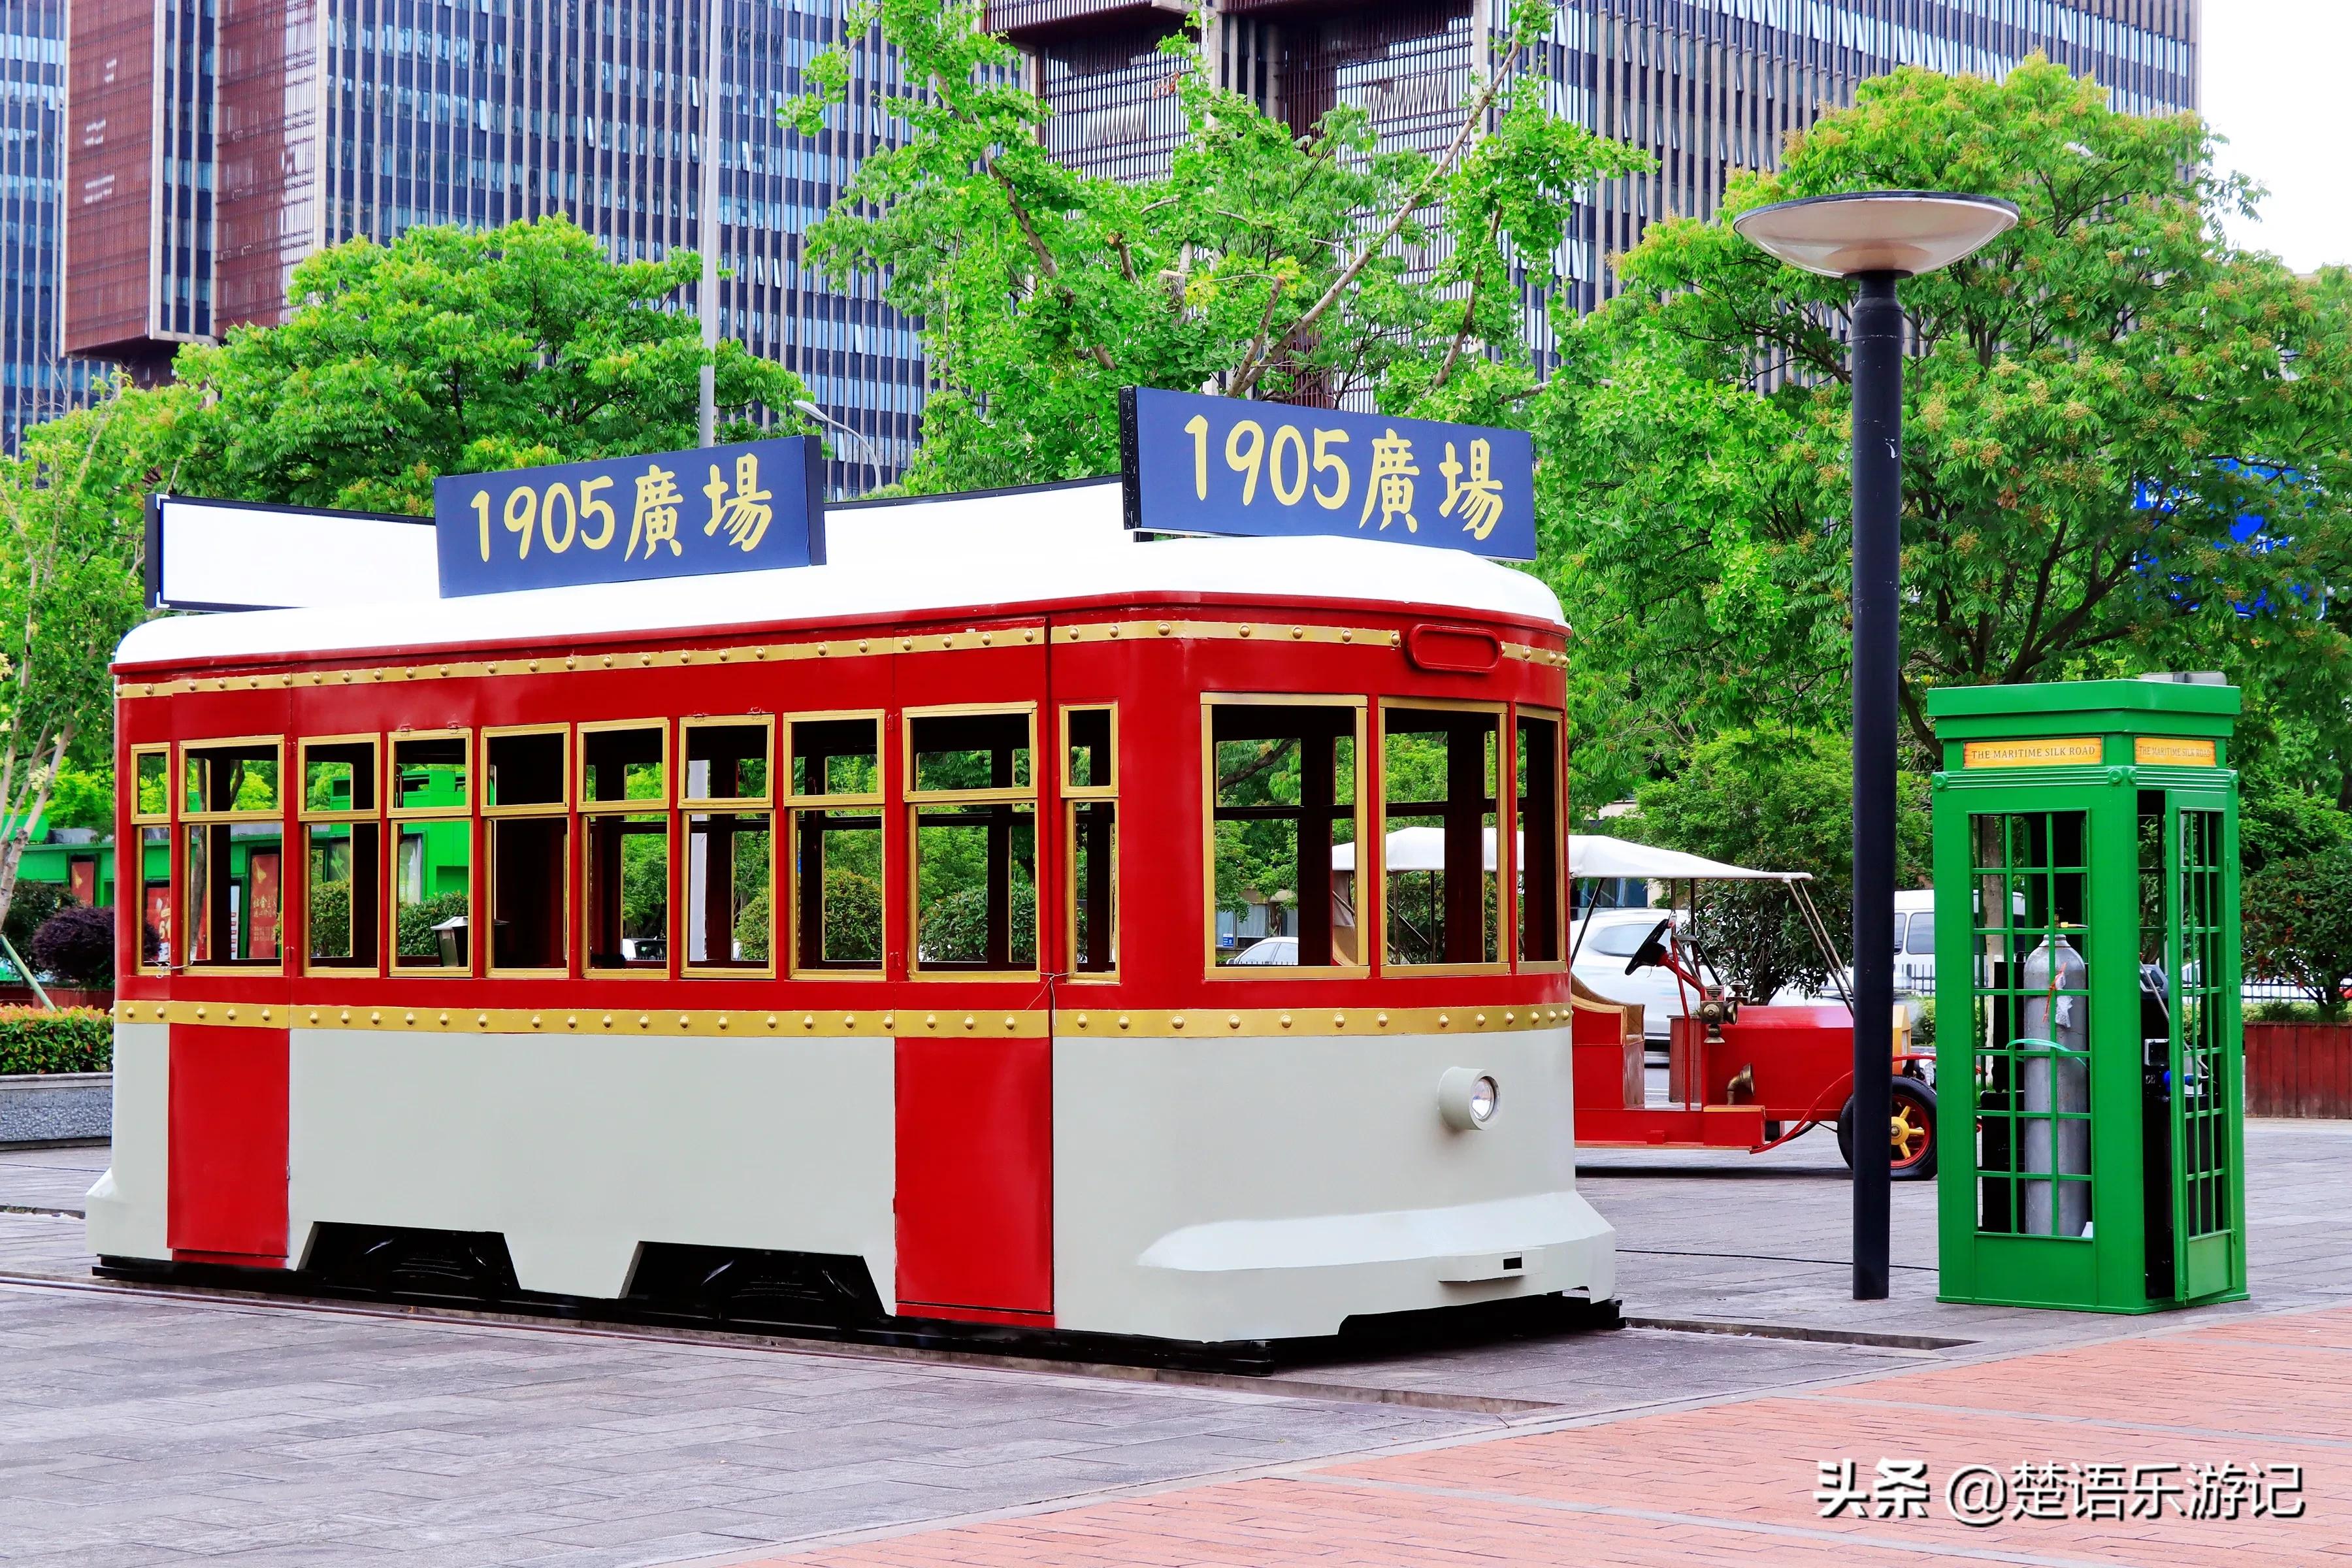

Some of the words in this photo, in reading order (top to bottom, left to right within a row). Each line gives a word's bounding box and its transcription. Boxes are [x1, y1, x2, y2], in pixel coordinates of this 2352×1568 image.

[470, 452, 773, 562] 1905廣場
[1184, 414, 1503, 541] 1905廣場
[1971, 750, 1991, 759] THE
[1993, 748, 2042, 759] MARITIME
[2045, 747, 2066, 757] SILK
[2069, 745, 2096, 756] ROAD
[2139, 745, 2151, 755] THE
[2152, 747, 2181, 757] MARITIME
[2196, 749, 2212, 758] ROAD
